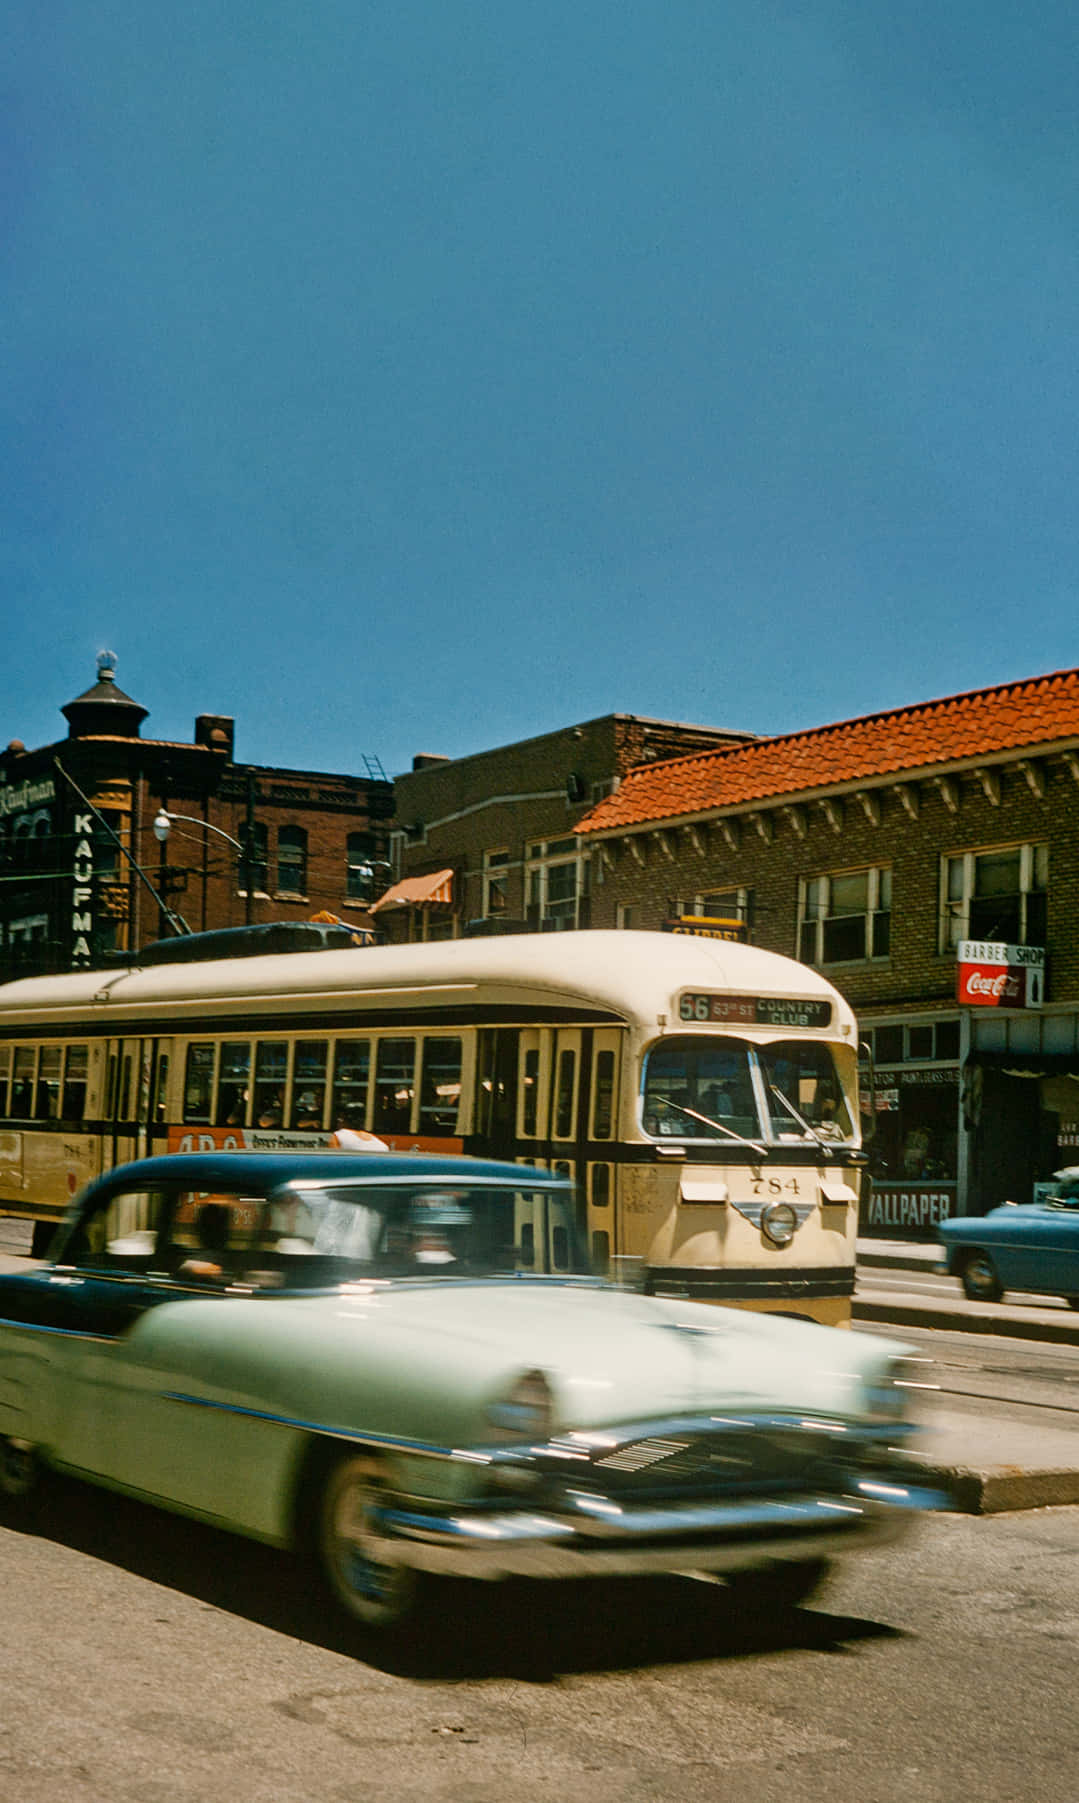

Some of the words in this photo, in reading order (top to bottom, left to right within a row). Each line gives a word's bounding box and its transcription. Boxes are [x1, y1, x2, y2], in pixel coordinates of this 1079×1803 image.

[72, 814, 93, 967] KAUFMA
[963, 944, 1008, 961] BARBER
[1016, 947, 1045, 963] SHOP
[680, 996, 709, 1019] 56
[757, 1000, 823, 1015] COUNTRY
[771, 1012, 809, 1025] CLUB
[749, 1177, 800, 1195] 784
